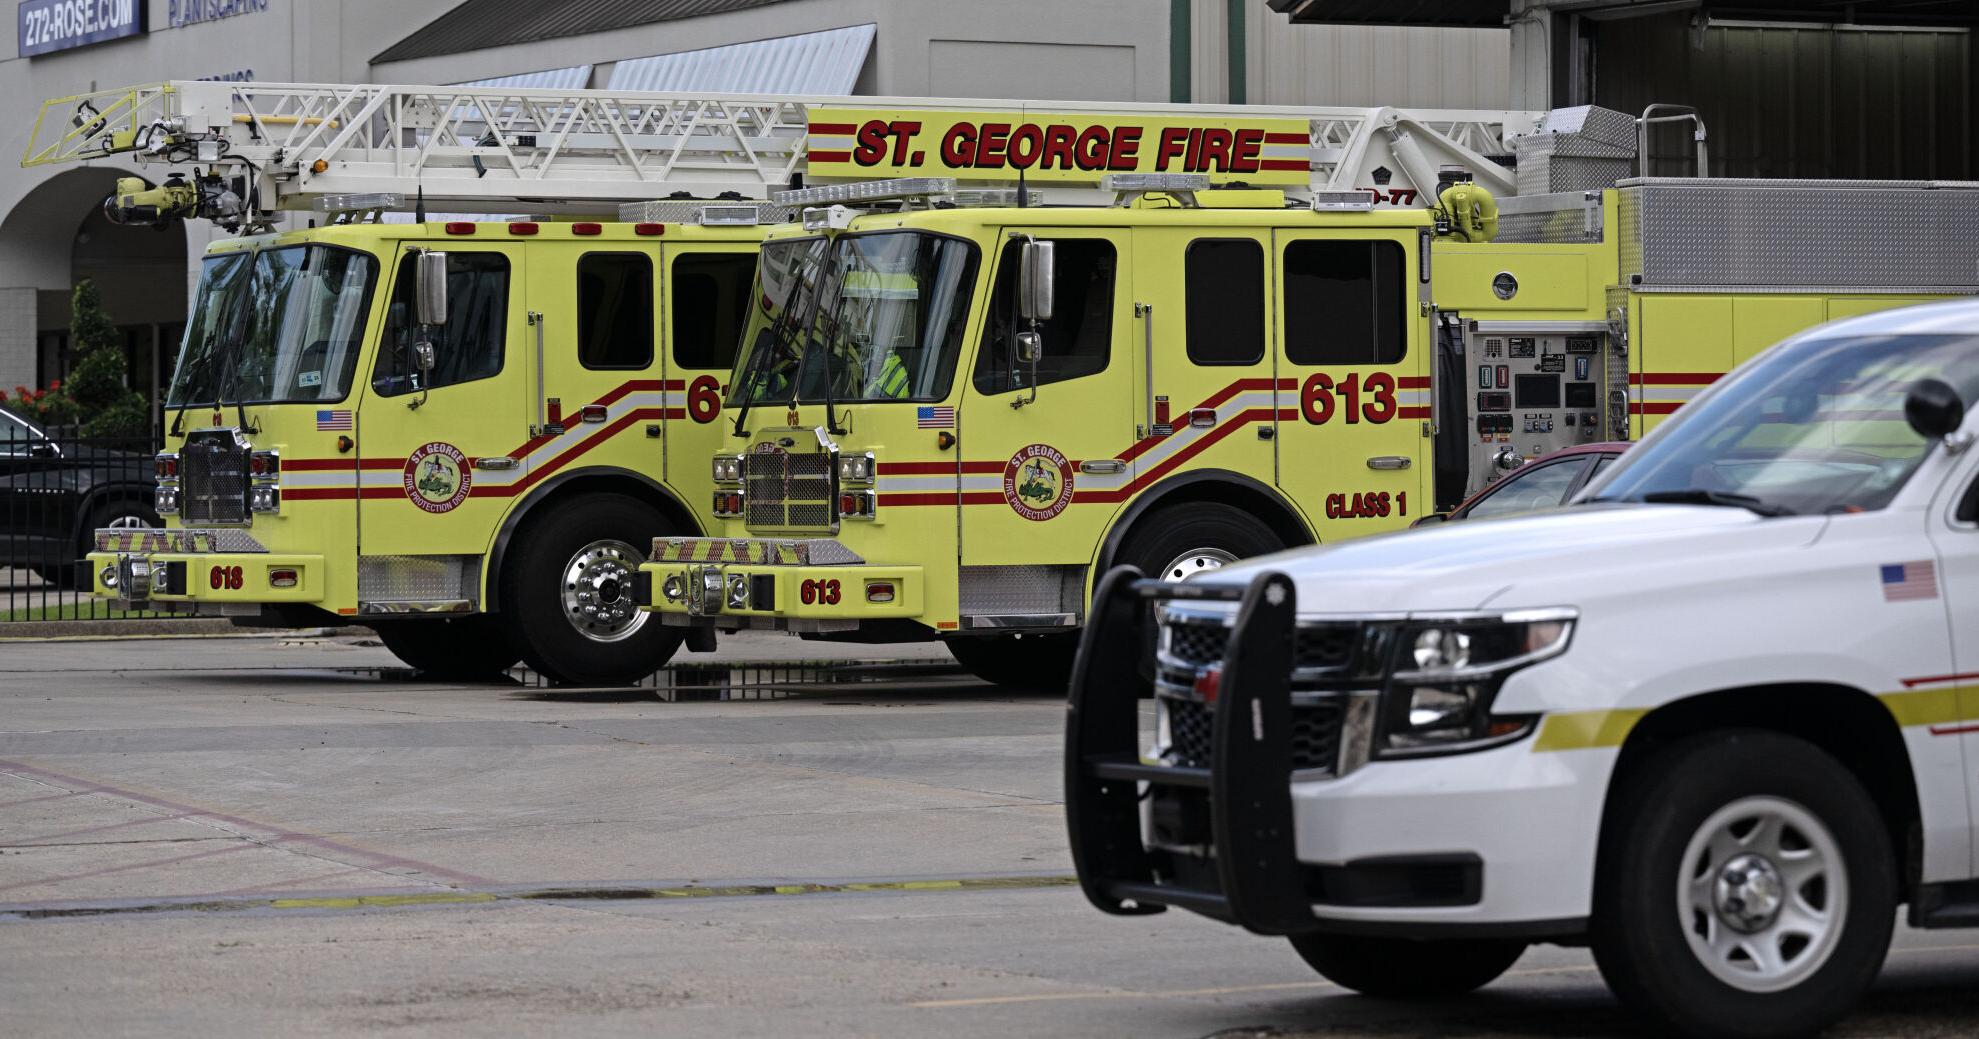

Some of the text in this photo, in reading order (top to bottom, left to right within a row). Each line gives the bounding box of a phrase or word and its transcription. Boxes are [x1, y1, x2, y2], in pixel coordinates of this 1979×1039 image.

[26, 0, 132, 46] 272-ROSE.COM
[853, 119, 1265, 173] ST. GEORGE FIRE
[687, 374, 728, 424] 6
[1300, 371, 1397, 425] 613
[411, 443, 465, 464] ST. GEORGE
[1011, 445, 1067, 468] ST. GEORGE
[405, 473, 471, 513] FIRE PROTECTION DISTRICT
[1005, 478, 1073, 520] FIRE PROTECTION DISTRICT
[1325, 491, 1407, 519] CLASS 1
[210, 565, 244, 590] 618
[800, 578, 842, 605] 613
